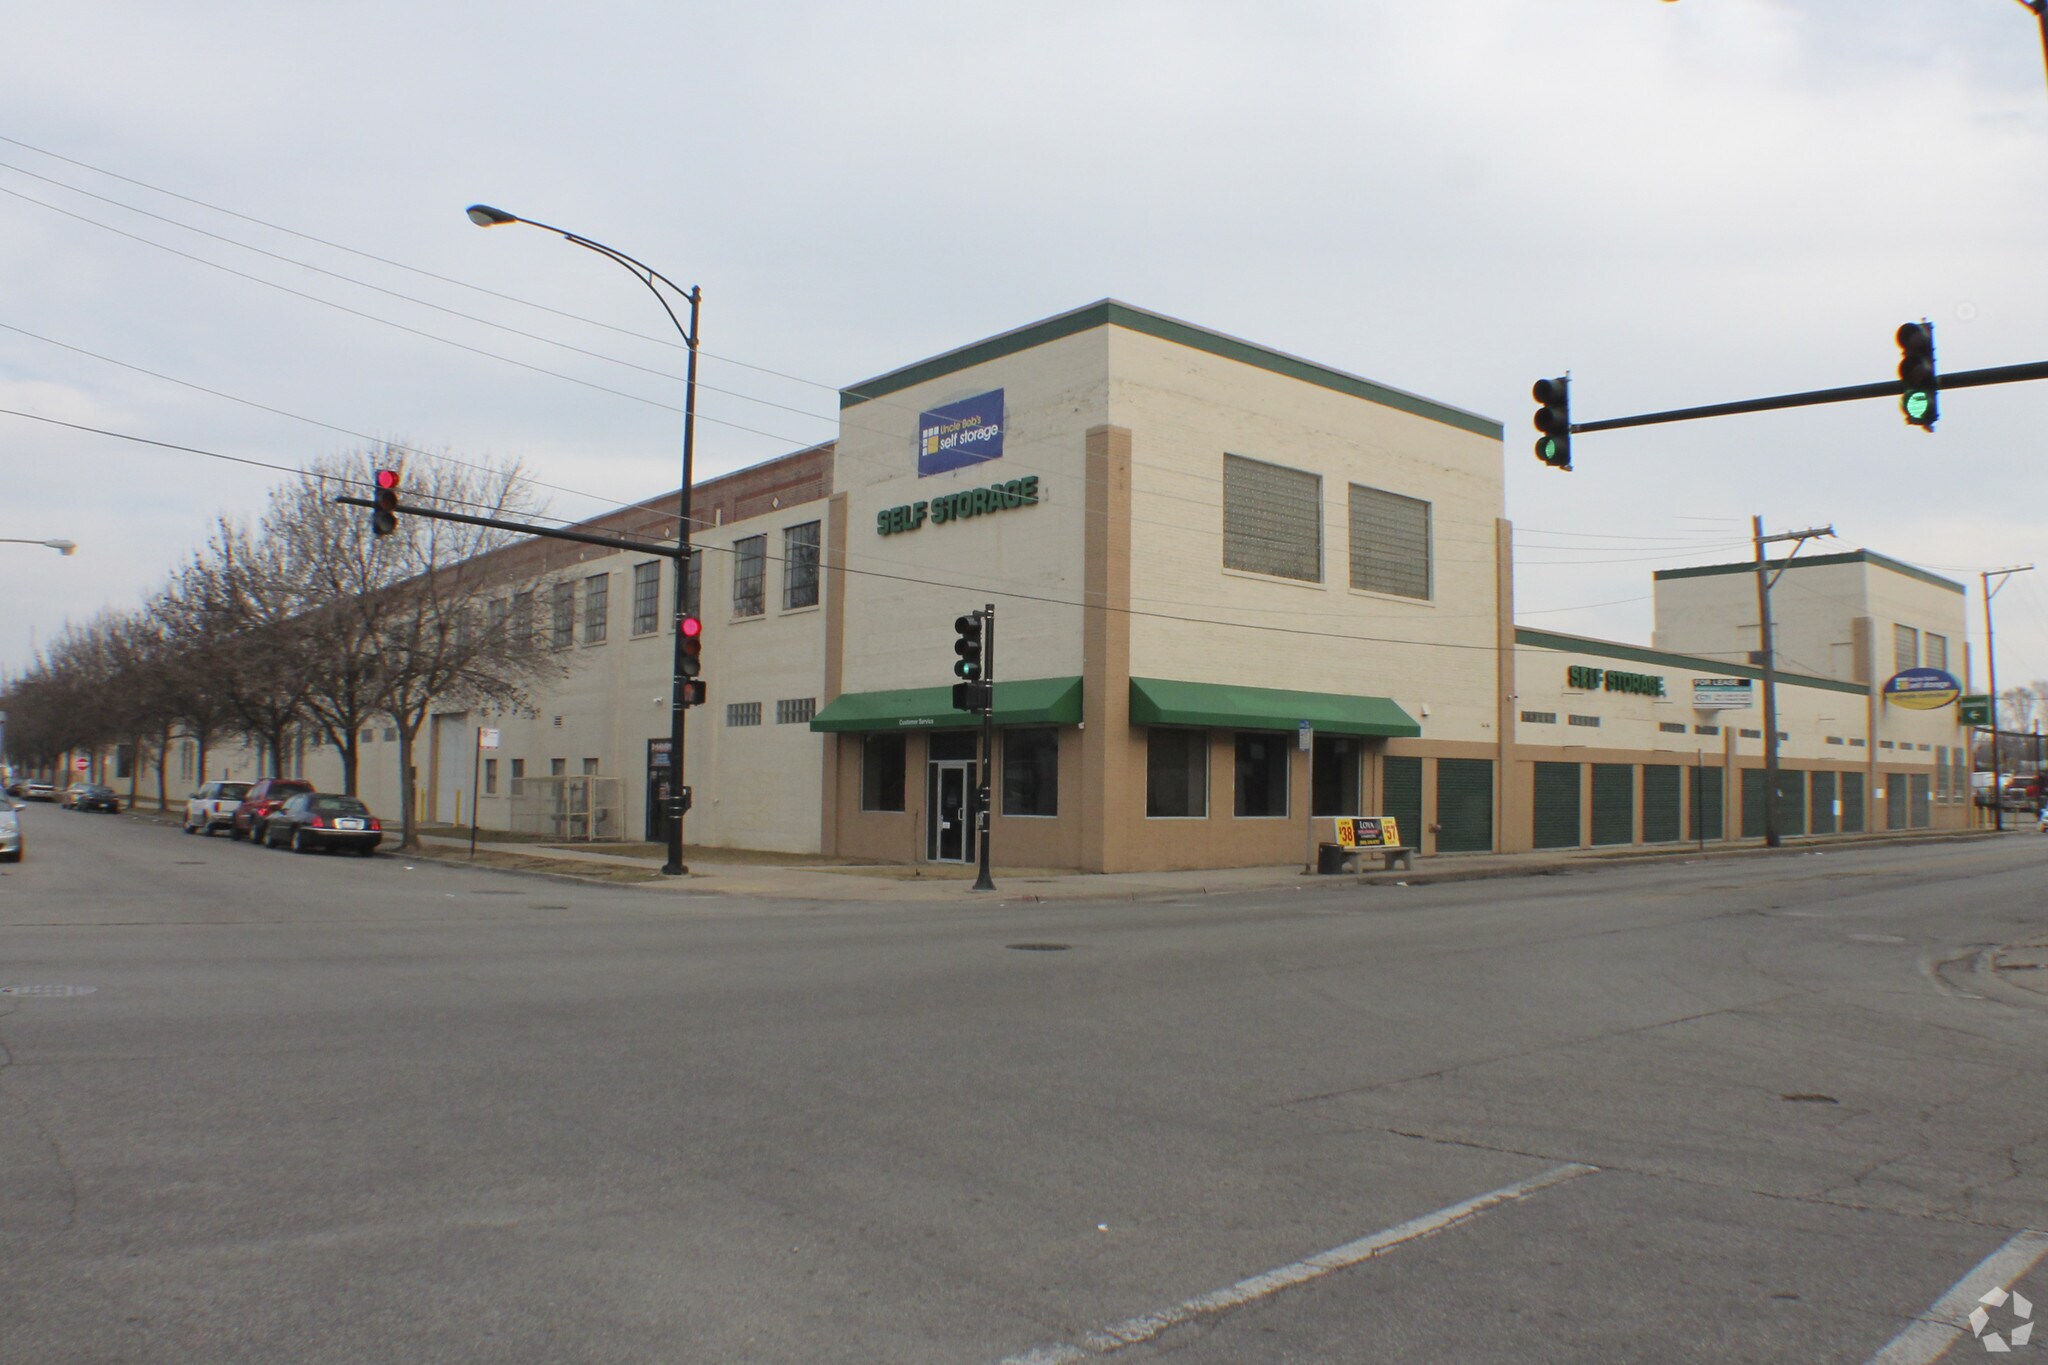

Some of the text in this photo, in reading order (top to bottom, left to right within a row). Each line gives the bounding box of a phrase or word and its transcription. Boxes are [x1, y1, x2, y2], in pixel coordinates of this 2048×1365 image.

[940, 415, 981, 435] Uncle Bob's
[940, 424, 998, 450] self storage
[876, 475, 1039, 537] SELF STORAGE
[1568, 664, 1666, 697] SELF STORAGE
[1339, 826, 1353, 842] $38
